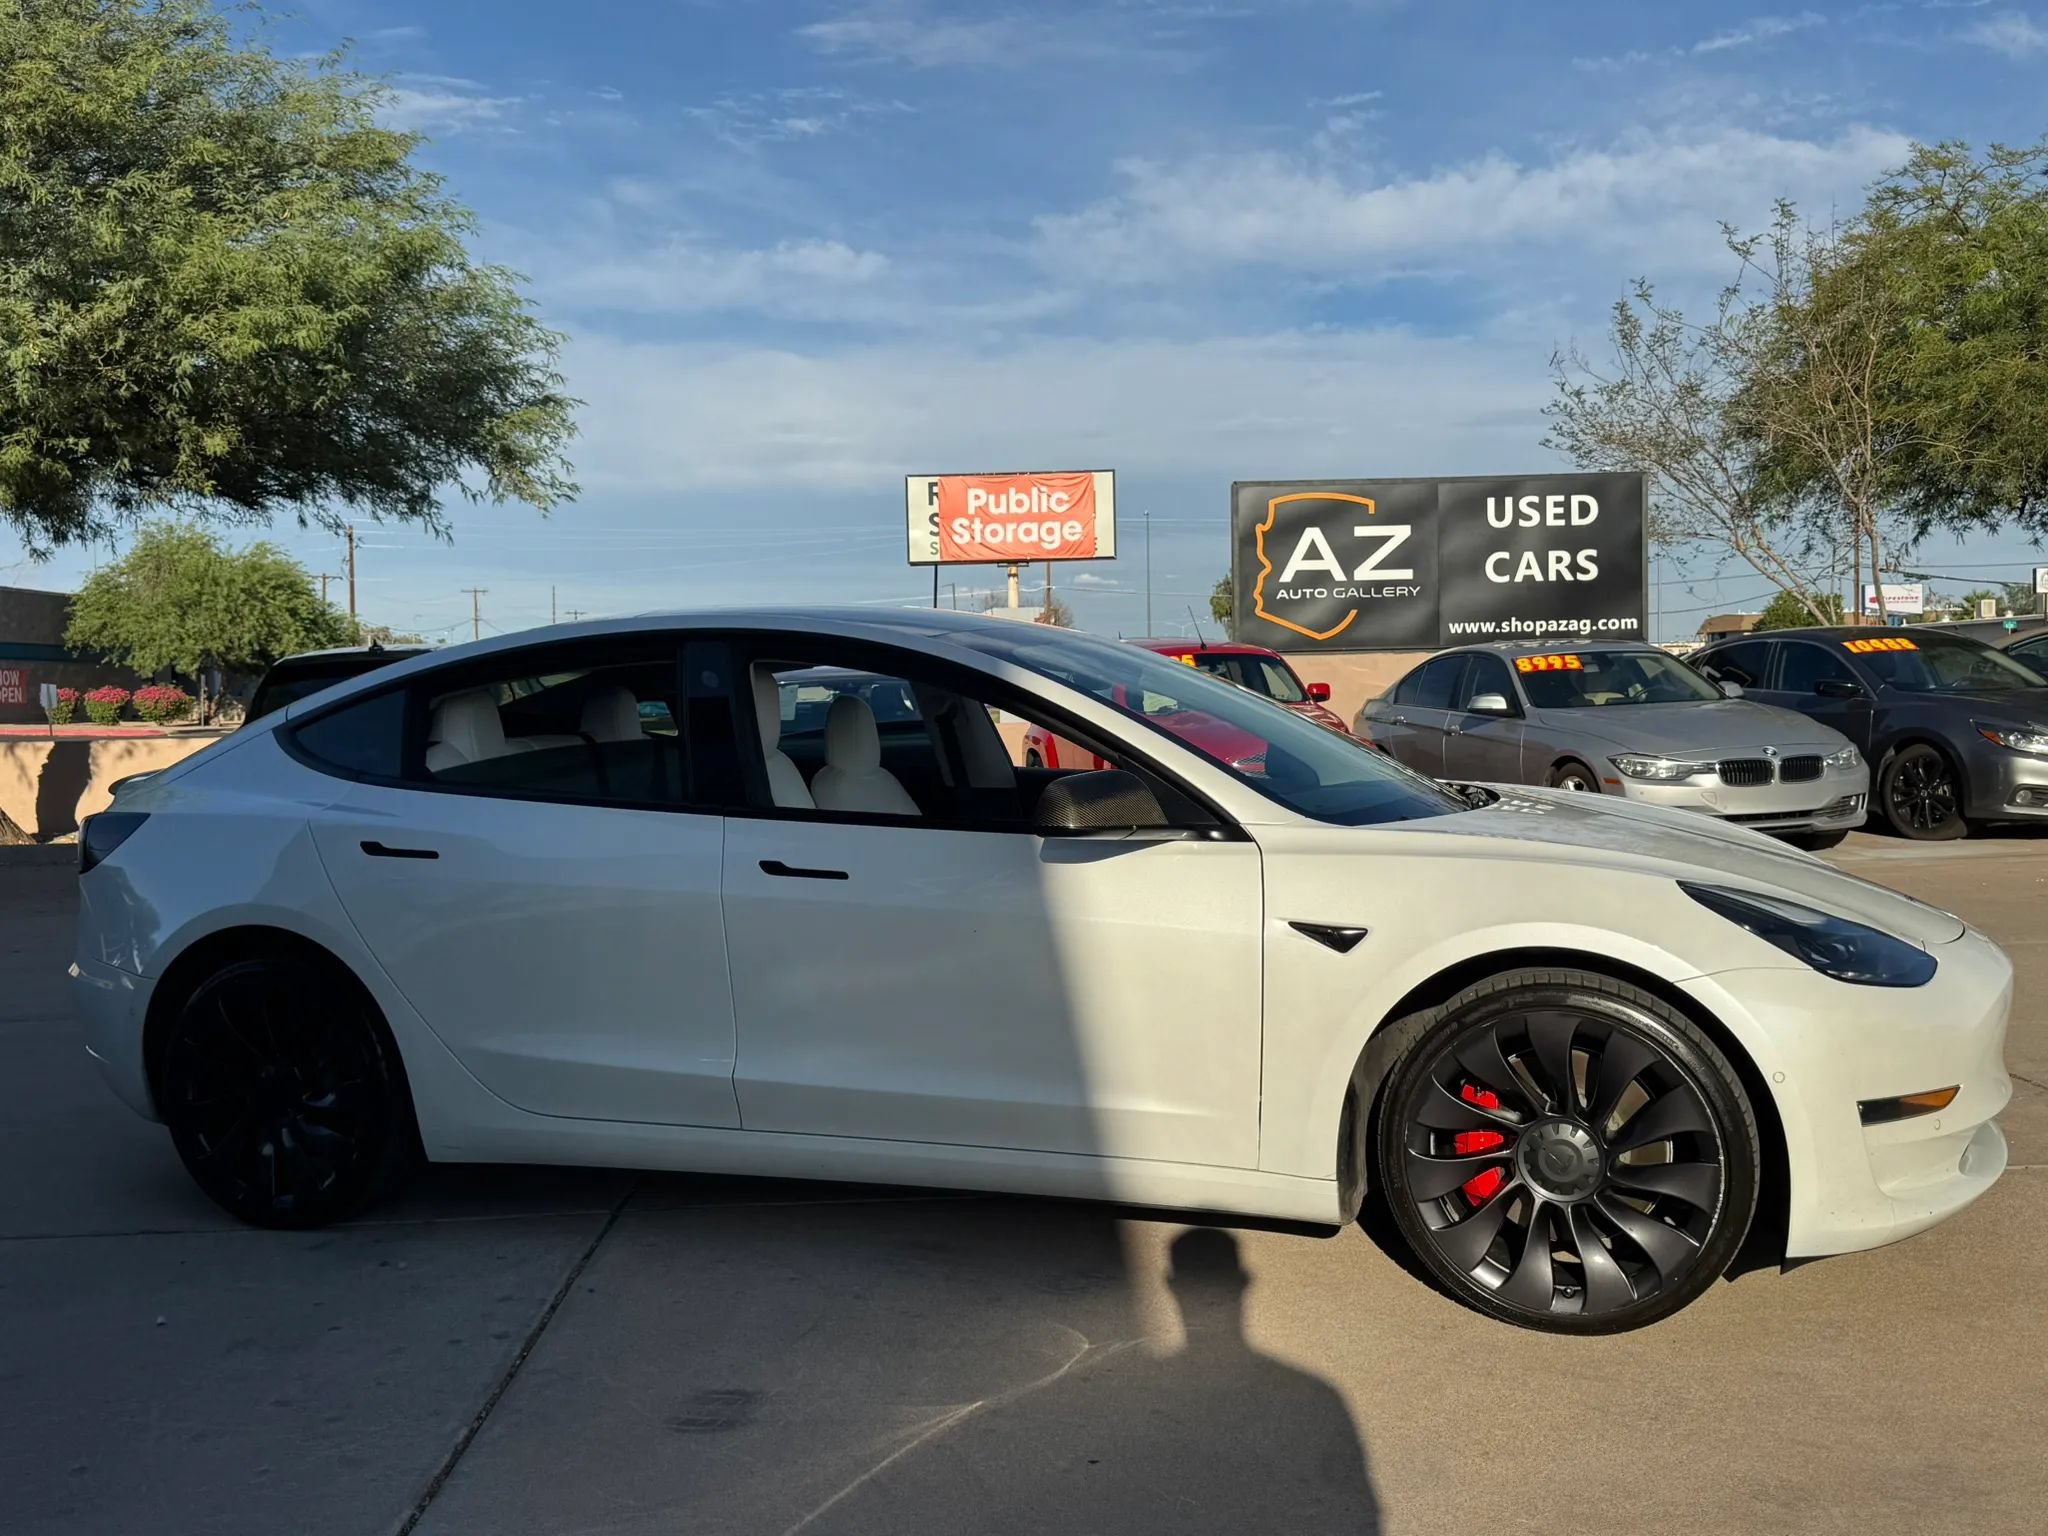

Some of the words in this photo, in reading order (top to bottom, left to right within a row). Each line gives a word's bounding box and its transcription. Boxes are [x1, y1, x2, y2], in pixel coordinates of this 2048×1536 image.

[967, 486, 1070, 515] Public
[1487, 495, 1598, 528] USED
[952, 517, 1082, 549] Storage
[1279, 525, 1413, 582] AZ
[1485, 549, 1598, 583] CARS
[1276, 588, 1327, 599] AUTO
[1333, 586, 1420, 598] GALLERY
[1448, 616, 1638, 636] www.shopazag.com
[1516, 655, 1581, 672] 8995
[0, 686, 22, 703] PEN
